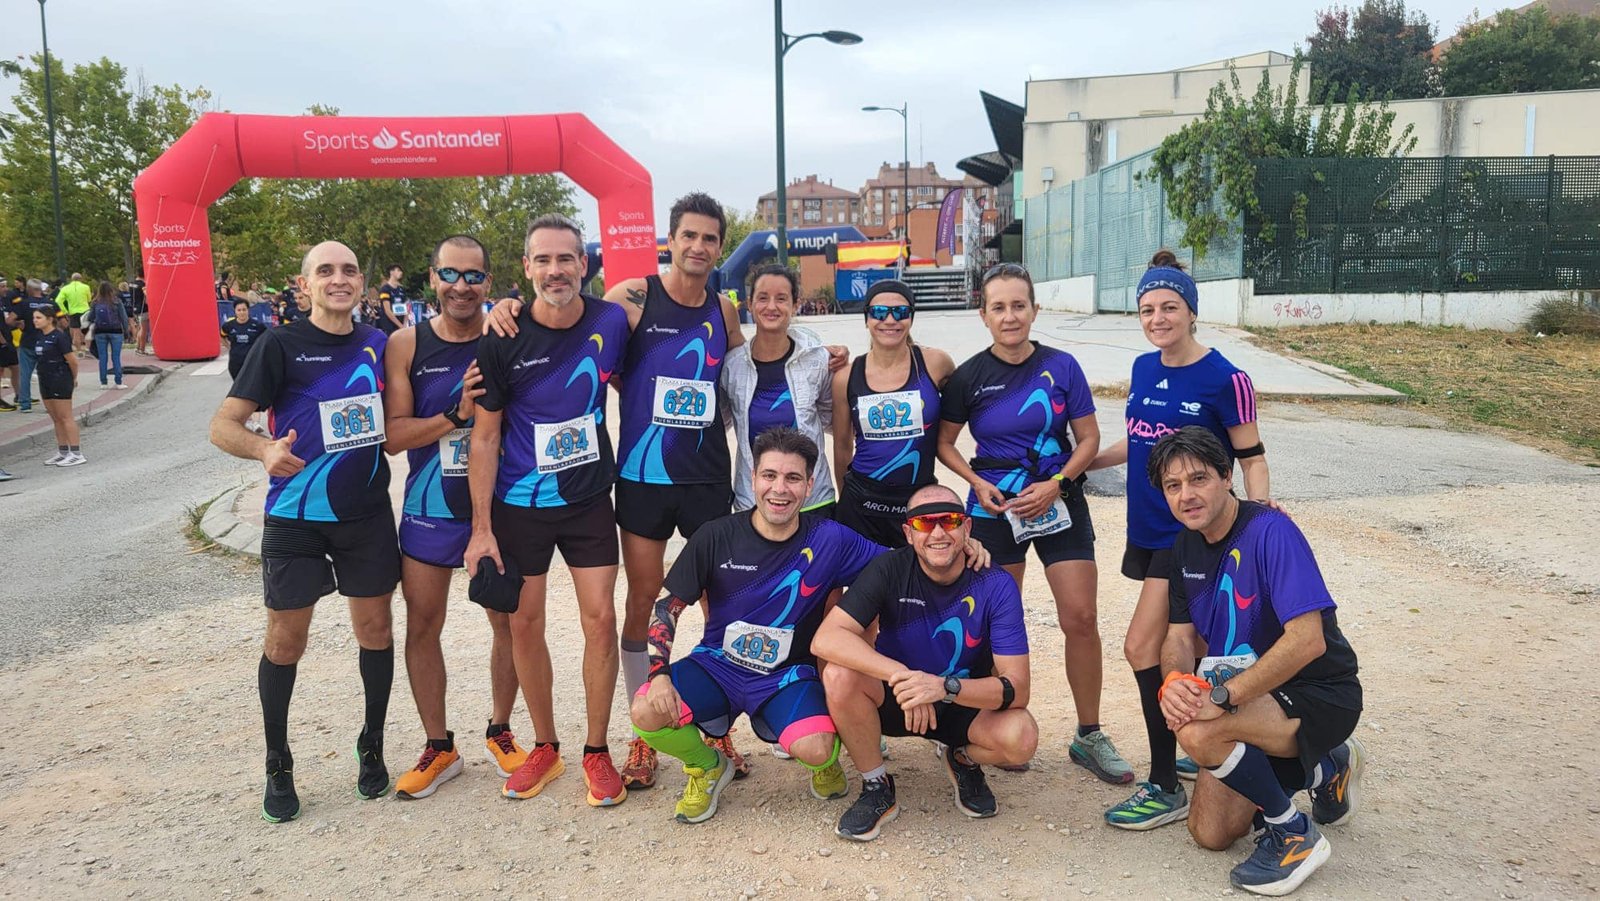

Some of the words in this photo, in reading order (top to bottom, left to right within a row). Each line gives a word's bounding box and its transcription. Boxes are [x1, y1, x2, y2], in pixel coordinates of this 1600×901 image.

[303, 130, 369, 153] Sports
[402, 130, 501, 149] Santander
[371, 155, 437, 165] sportssantander.es
[618, 211, 645, 221] Sports
[153, 224, 185, 234] Sports
[152, 239, 201, 247] Santander
[795, 232, 838, 250] mupol
[664, 389, 707, 416] 620
[331, 405, 376, 438] 961
[868, 401, 913, 430] 692
[449, 440, 468, 465] 7
[545, 427, 589, 460] 494
[891, 505, 908, 514] MA
[731, 634, 780, 664] 493
